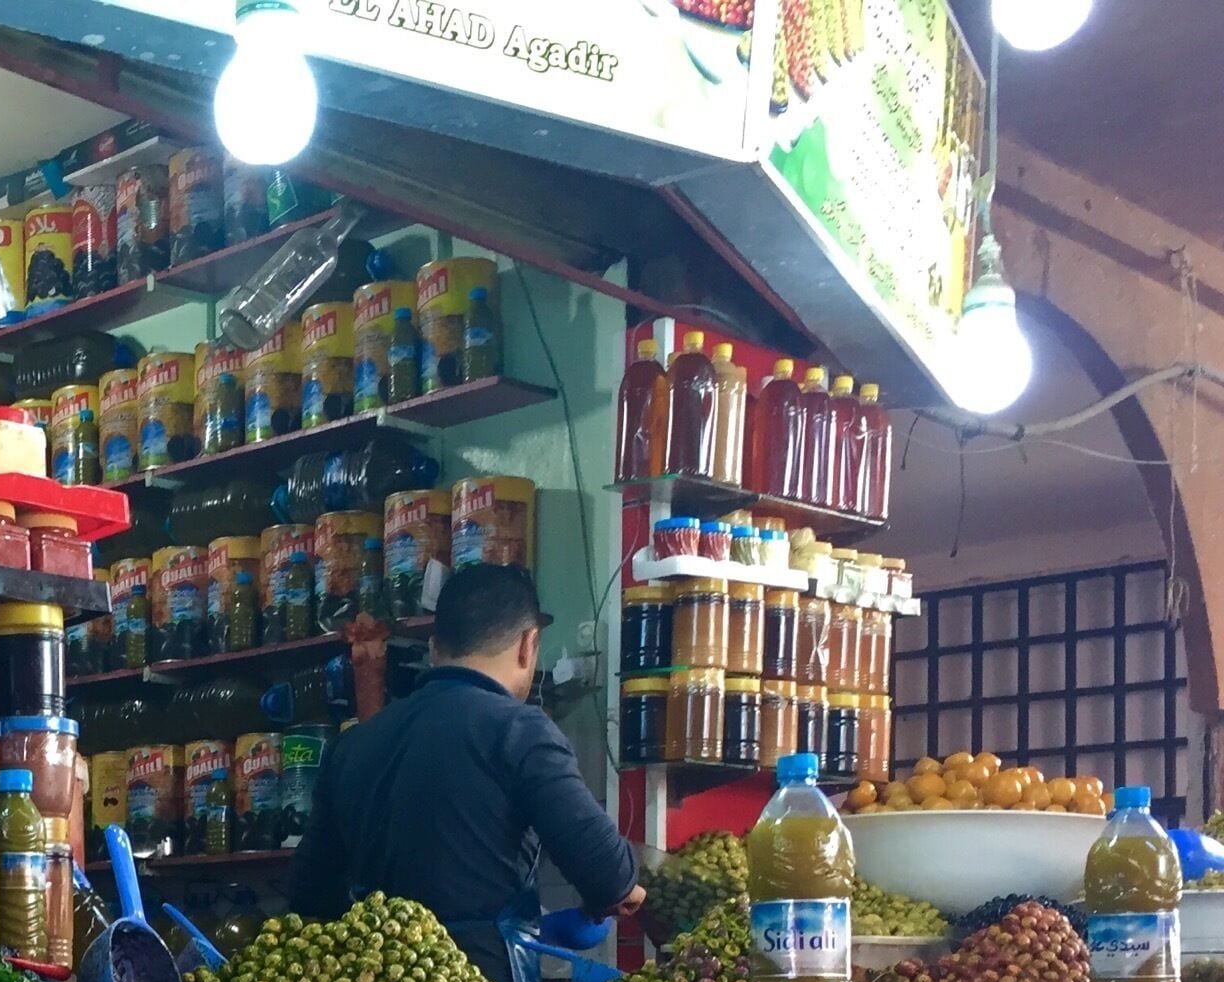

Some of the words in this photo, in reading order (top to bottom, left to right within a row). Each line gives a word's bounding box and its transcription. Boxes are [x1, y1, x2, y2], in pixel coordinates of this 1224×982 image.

[388, 0, 496, 49] AHAD
[503, 25, 618, 81] Agadir
[763, 926, 805, 952] Sidi
[809, 929, 836, 951] ali
